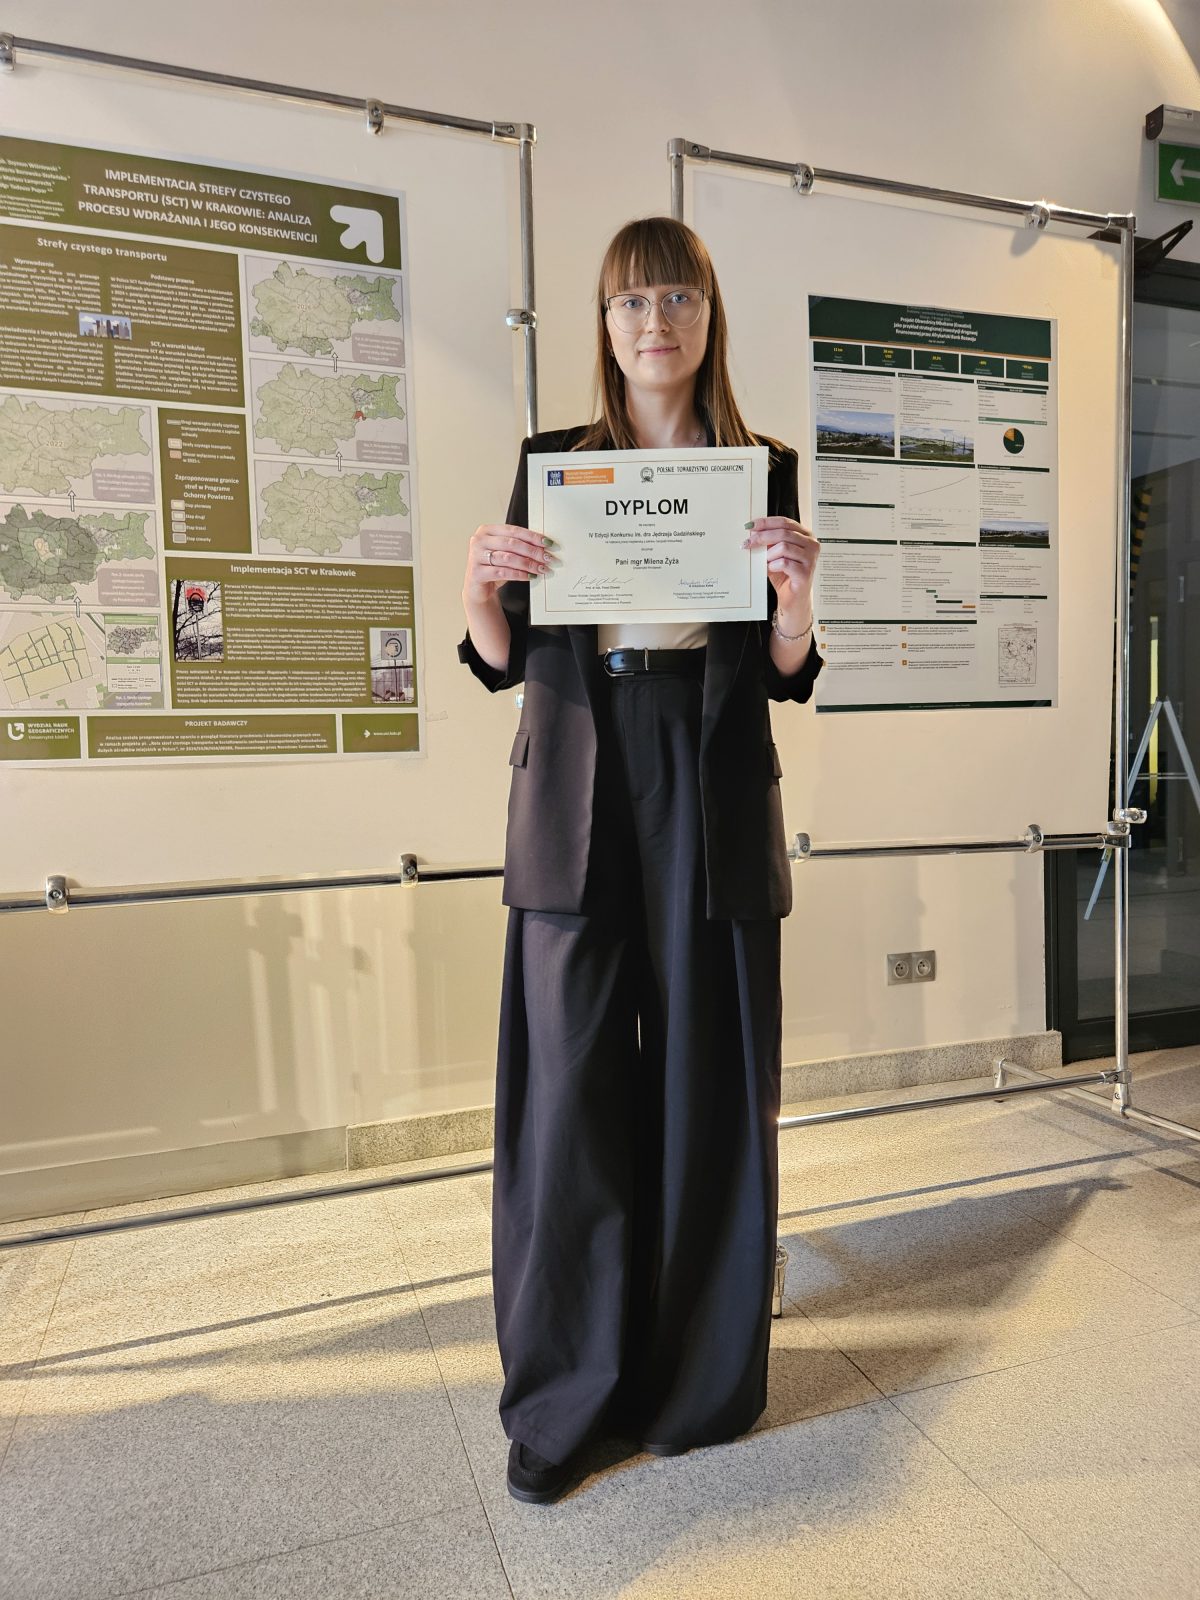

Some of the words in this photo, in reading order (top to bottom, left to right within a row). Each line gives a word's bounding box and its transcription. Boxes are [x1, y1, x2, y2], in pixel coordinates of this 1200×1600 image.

[105, 169, 197, 192] IMPLEMENTACJA
[199, 183, 237, 198] STREFY
[239, 189, 291, 206] CZYSTEGO
[83, 184, 159, 204] TRANSPORTU
[161, 195, 189, 210] (SCT)
[191, 199, 203, 210] W
[205, 201, 266, 219] KRAKOWIE:
[267, 211, 312, 226] ANALIZA
[78, 201, 130, 217] PROCESU
[132, 207, 201, 227] WDRAŻANIA
[209, 218, 237, 232] JEGO
[239, 223, 318, 244] KONSEKWENCJI
[37, 238, 67, 251] Strefy
[71, 243, 112, 255] czystego
[115, 247, 167, 261] transportu
[606, 499, 688, 516] DYPLOM
[230, 564, 292, 576] Implementacja
[293, 567, 309, 575] SCT
[319, 568, 356, 577] Krakowie
